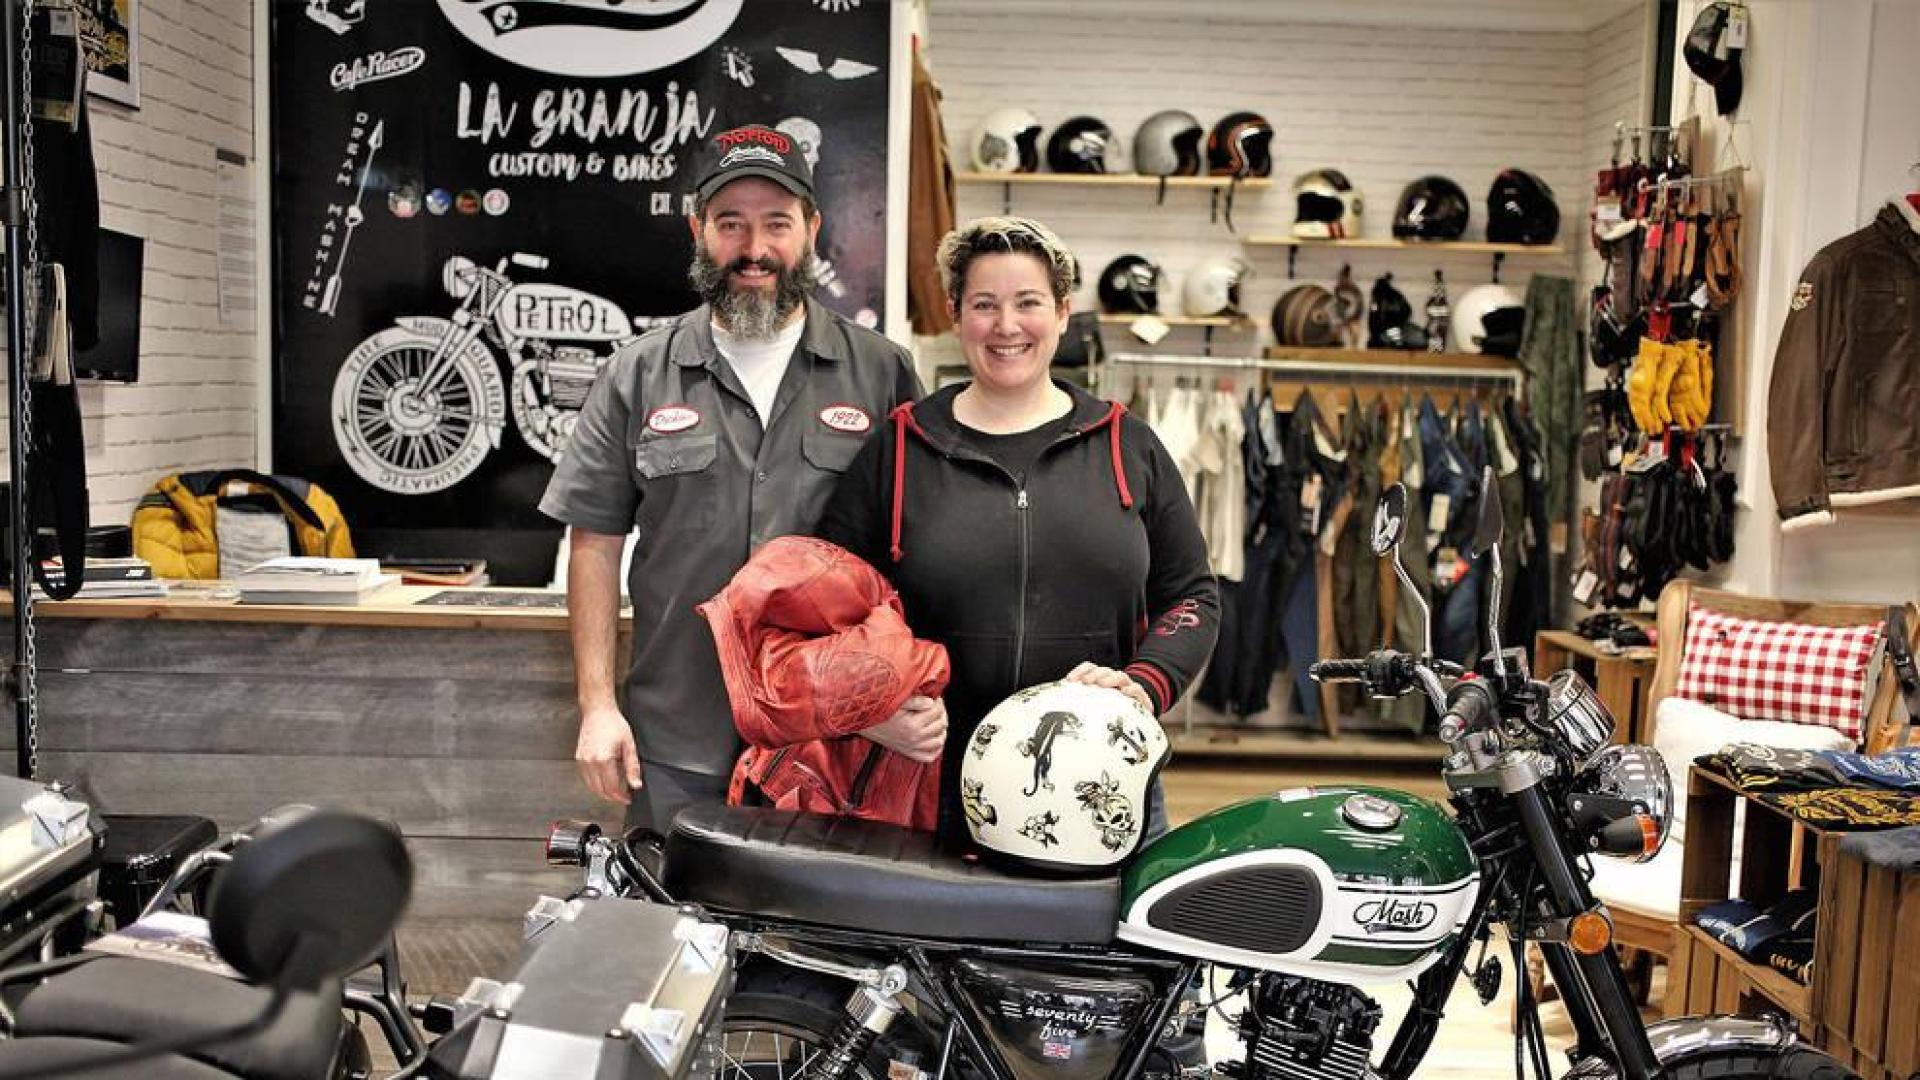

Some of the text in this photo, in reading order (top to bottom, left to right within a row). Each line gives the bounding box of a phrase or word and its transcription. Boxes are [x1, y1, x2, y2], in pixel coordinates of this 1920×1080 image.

[366, 49, 424, 76] Racer
[457, 80, 716, 154] LA GRANJA
[489, 152, 677, 181] CUSTOM & BIKES
[303, 203, 343, 309] MACHINE
[516, 293, 621, 334] PETROL
[378, 444, 482, 489] PNEUMATIC
[1354, 898, 1437, 927] Mash
[1025, 1004, 1097, 1031] seventy
[1039, 1019, 1077, 1040] five
